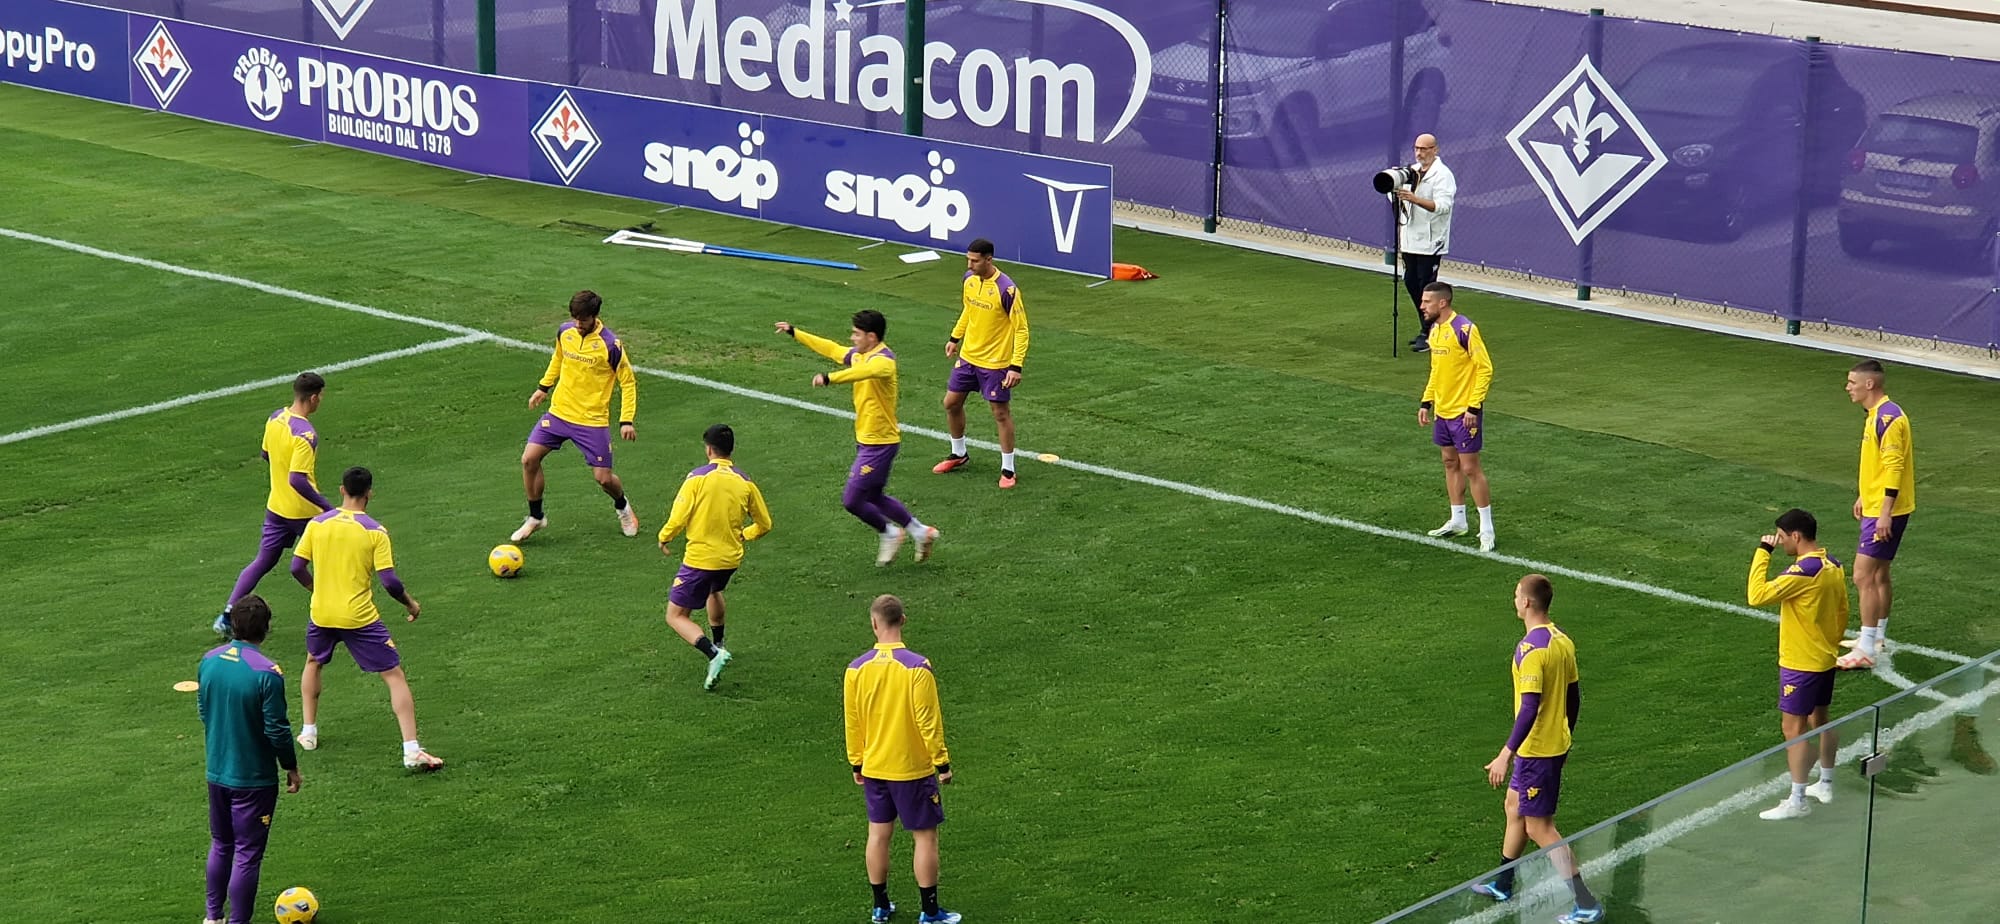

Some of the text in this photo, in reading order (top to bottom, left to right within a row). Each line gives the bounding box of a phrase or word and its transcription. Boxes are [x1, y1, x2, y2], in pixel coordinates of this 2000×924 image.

[233, 47, 293, 93] PROBIOS
[298, 56, 479, 137] PROBIOS
[652, 0, 1096, 143] Mediacom
[328, 113, 452, 156] BIOLOGICO DAL 1978
[643, 142, 779, 210] snep
[824, 170, 971, 241] snep
